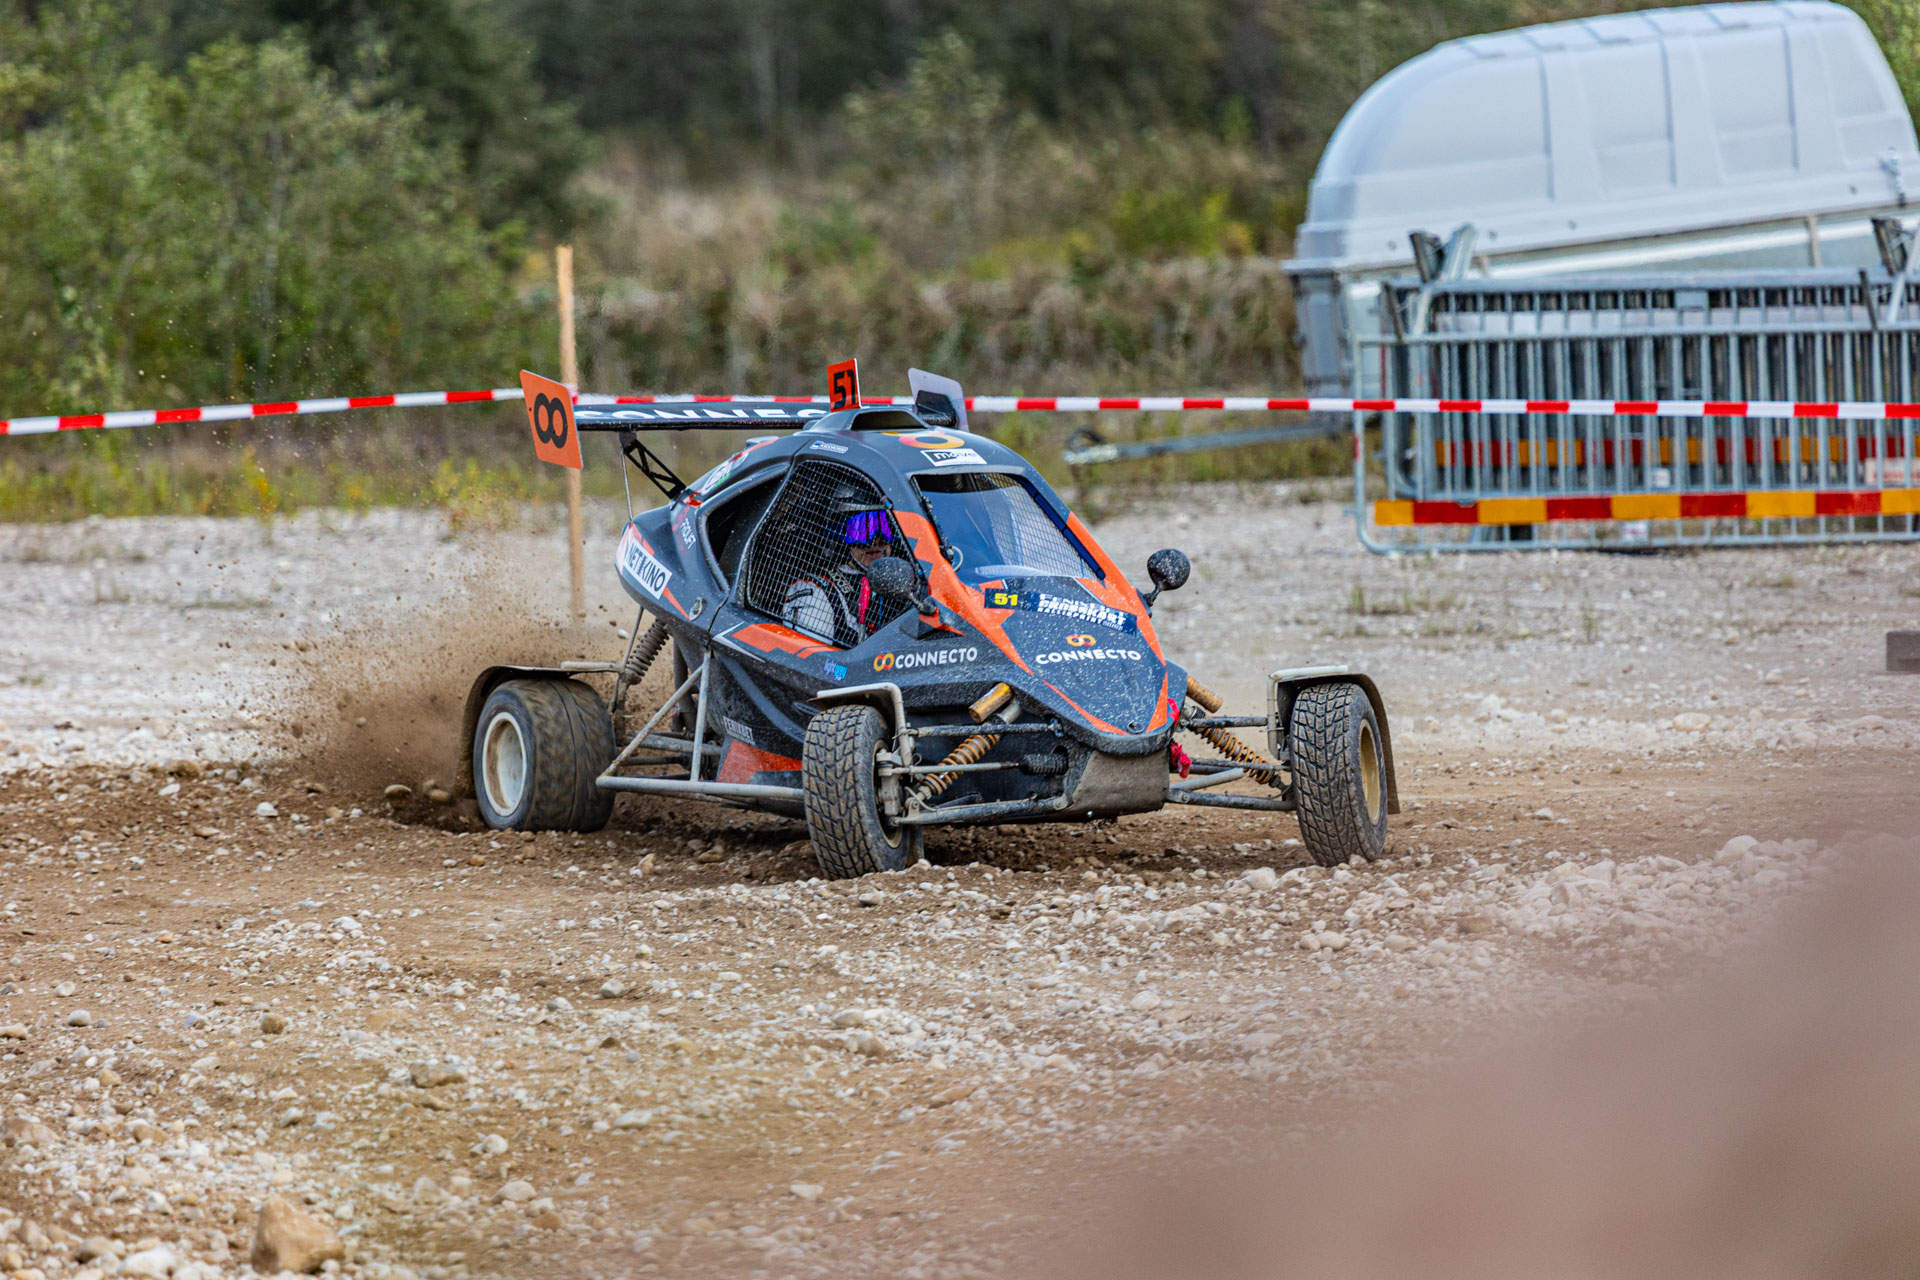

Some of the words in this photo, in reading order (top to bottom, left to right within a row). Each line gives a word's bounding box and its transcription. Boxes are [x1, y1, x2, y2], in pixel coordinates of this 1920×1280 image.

[833, 369, 856, 409] 51
[573, 408, 828, 419] CONNEC
[994, 592, 1019, 606] 51
[894, 646, 979, 670] CONNECTO
[1035, 649, 1142, 665] CONNECTO
